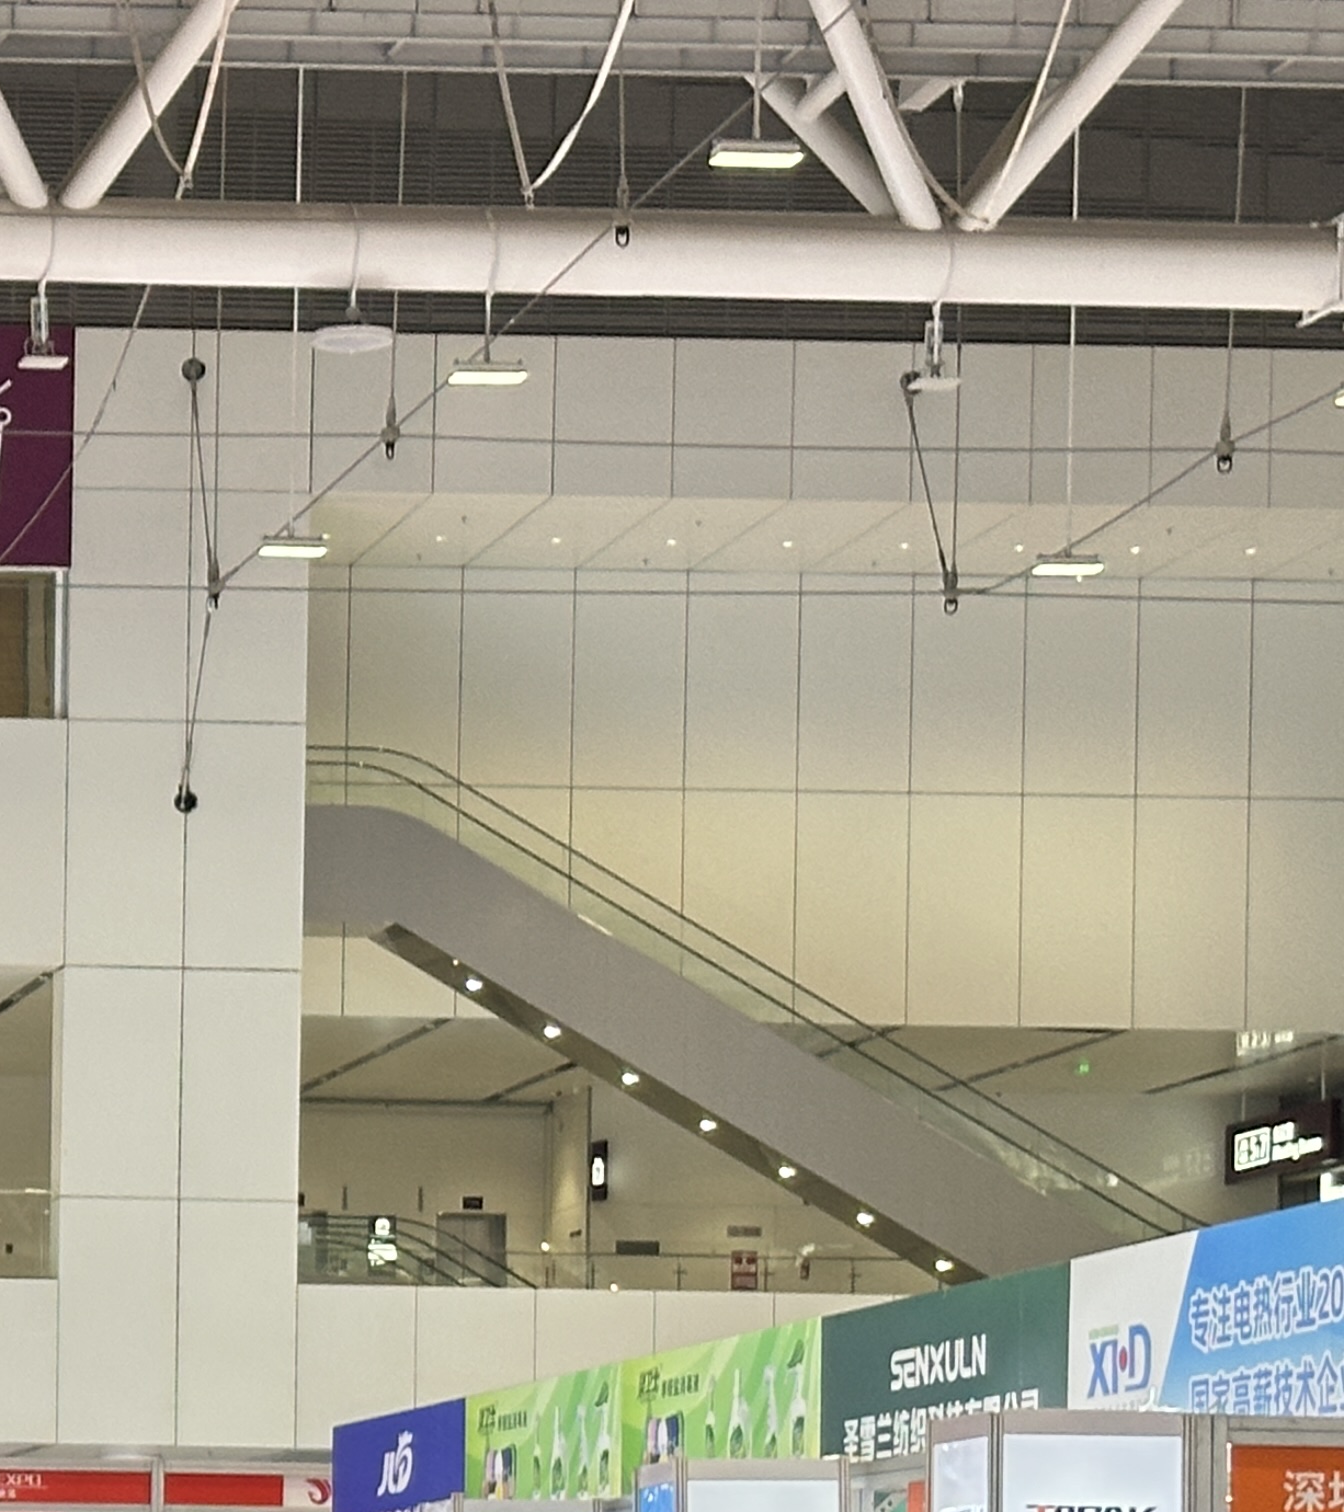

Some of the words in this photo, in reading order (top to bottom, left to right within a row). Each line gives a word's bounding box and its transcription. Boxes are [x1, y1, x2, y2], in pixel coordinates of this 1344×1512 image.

[890, 1334, 988, 1393] SENXULN
[1190, 1351, 1344, 1415] 国家高薪技术企
